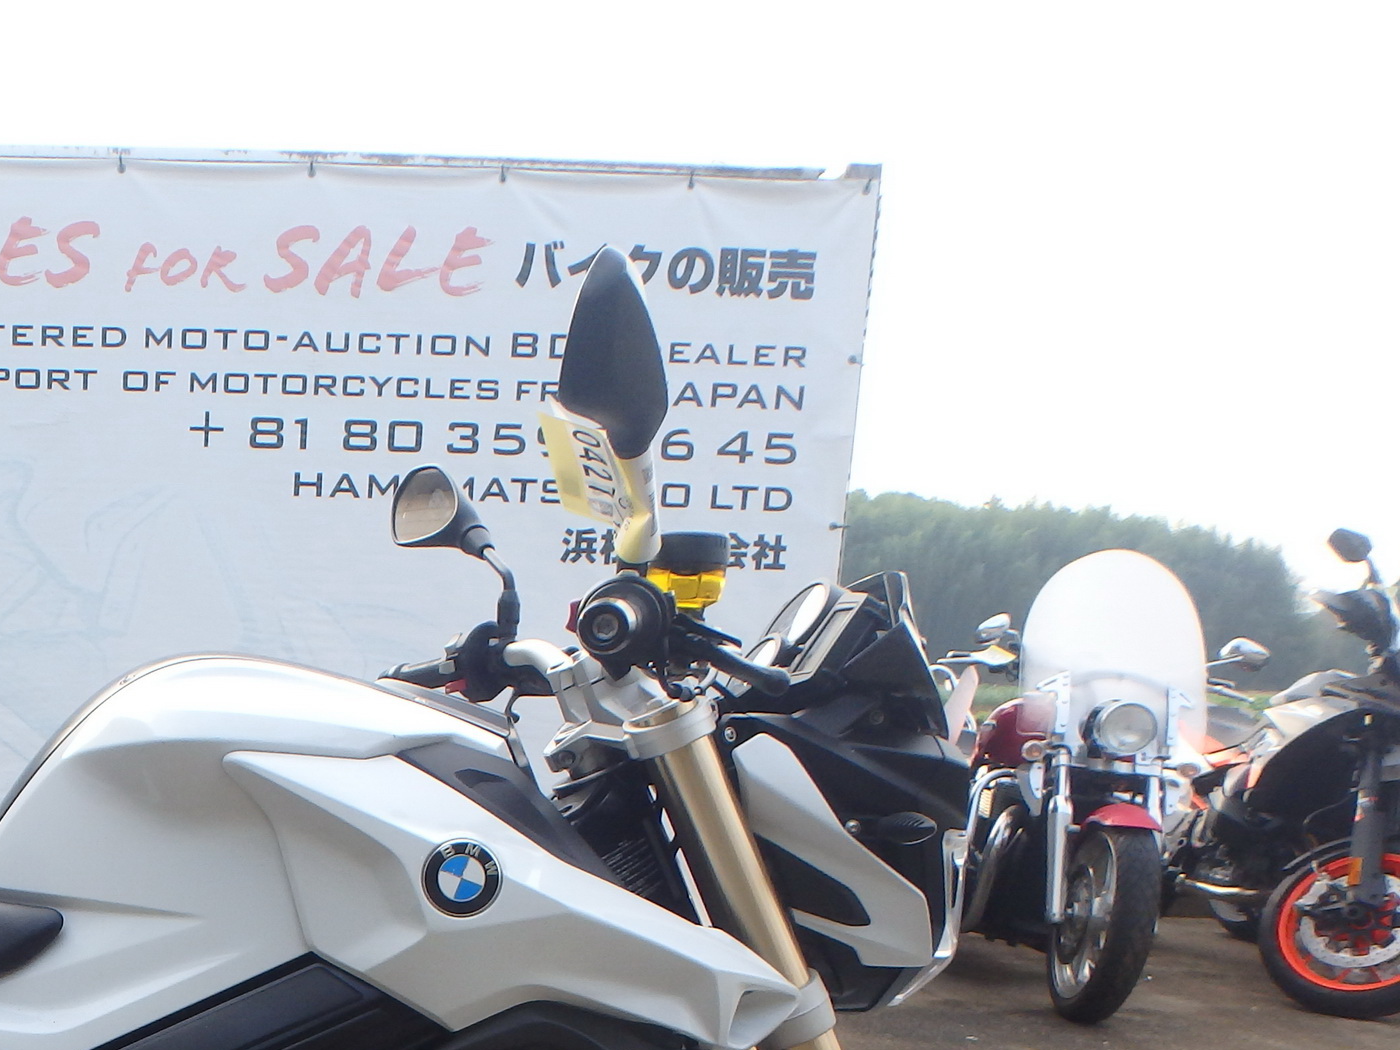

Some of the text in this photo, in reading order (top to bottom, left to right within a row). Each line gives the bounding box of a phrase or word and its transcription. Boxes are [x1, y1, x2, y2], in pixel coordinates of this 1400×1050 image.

[262, 225, 495, 299] SALE
[144, 327, 492, 358] MOTO-AUCTION
[510, 332, 568, 360] BD
[668, 342, 807, 368] EALER
[122, 370, 177, 393] OF
[189, 372, 500, 401] MOTORCYCLES
[516, 380, 560, 402] FR
[672, 381, 806, 411] APAN
[248, 416, 309, 450] 81
[342, 419, 425, 454] 80
[660, 482, 691, 509] O
[708, 484, 794, 513] LTD
[439, 842, 498, 876] BMW
